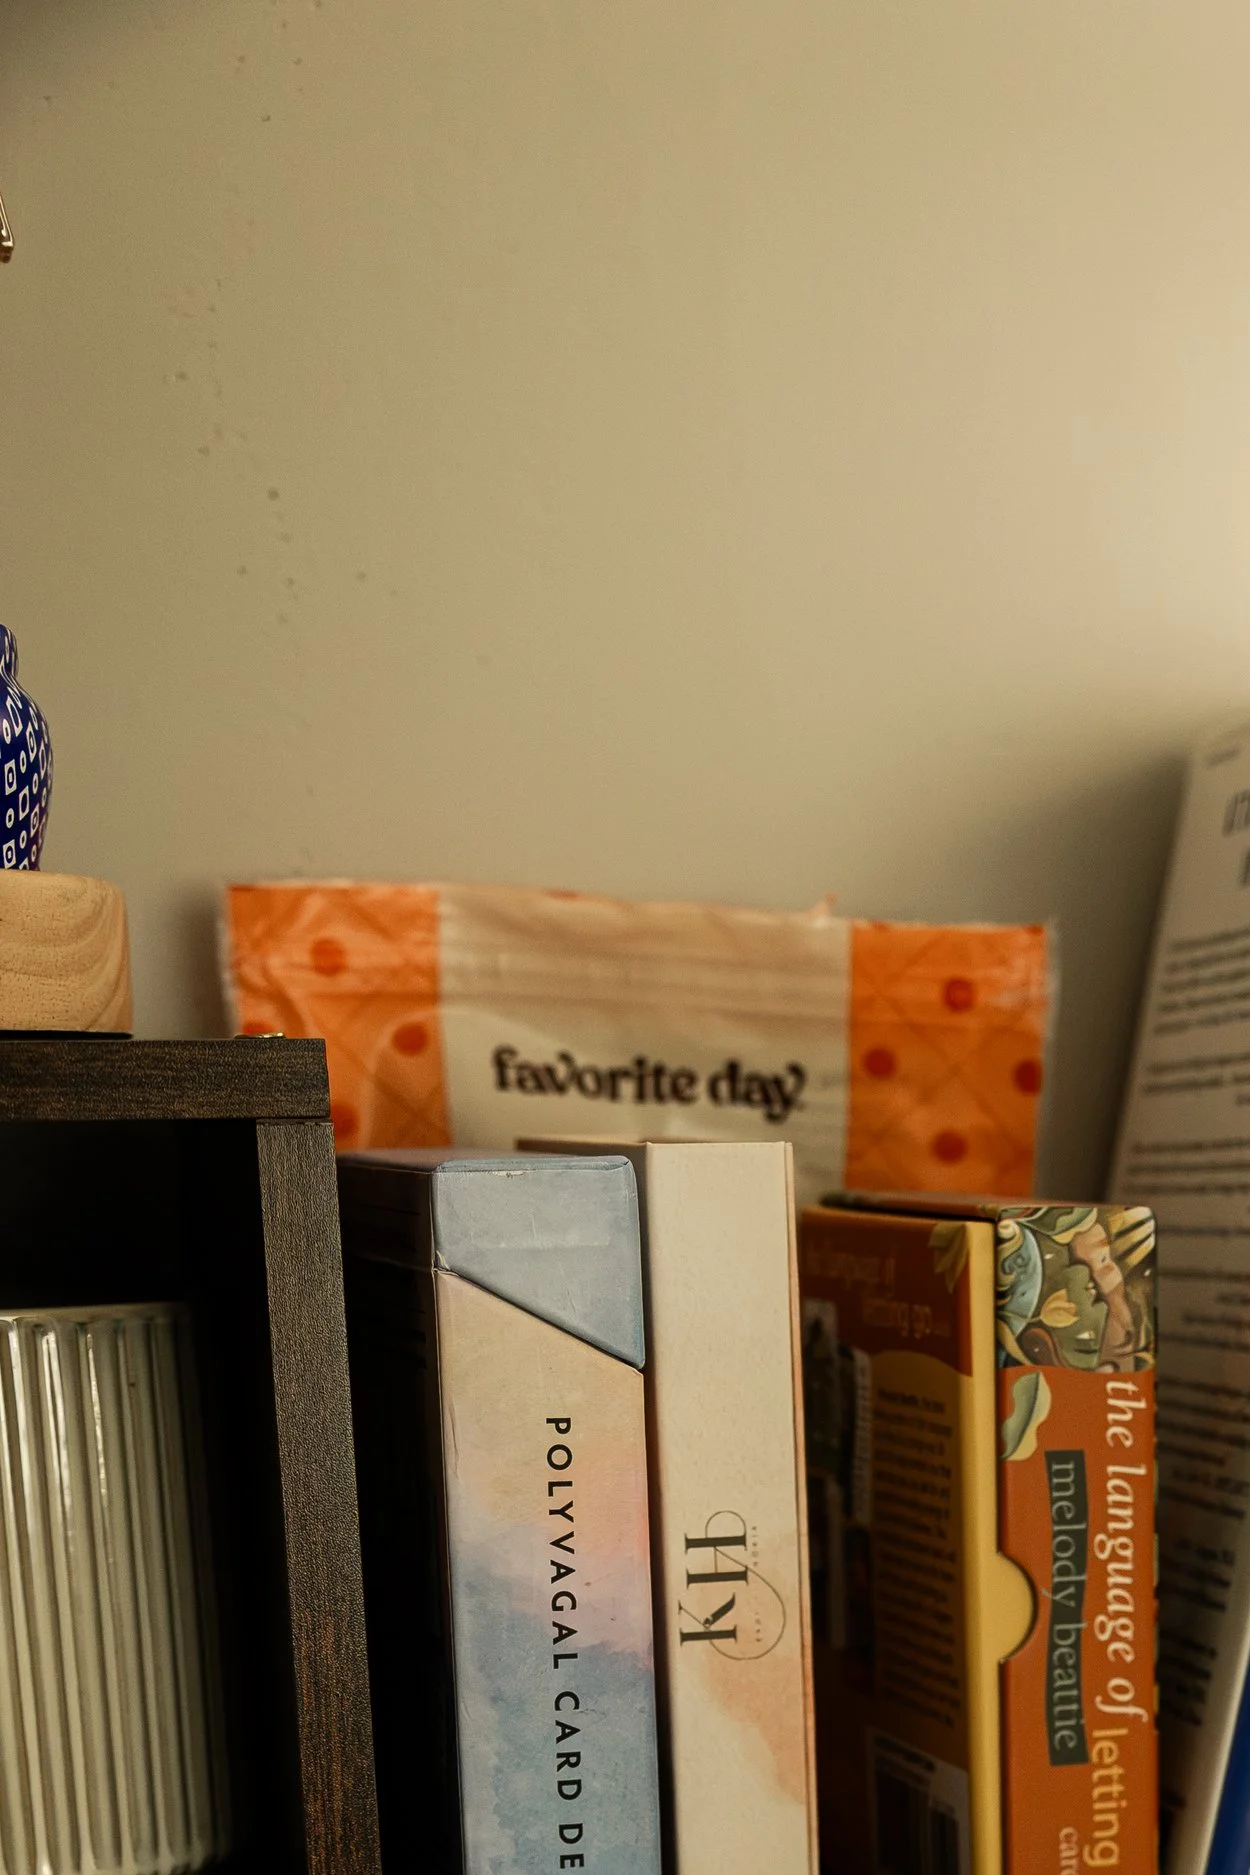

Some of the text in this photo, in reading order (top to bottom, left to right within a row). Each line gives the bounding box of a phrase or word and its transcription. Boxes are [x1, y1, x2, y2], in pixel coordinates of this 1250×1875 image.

[493, 1045, 698, 1106] favorite
[708, 1057, 807, 1124] day
[545, 1416, 579, 1670] POLYVAGAL
[1041, 1461, 1087, 1751] melody beattie
[1093, 1380, 1148, 1723] the language of
[551, 1690, 584, 1802] CARD
[1083, 1727, 1129, 1868] letting
